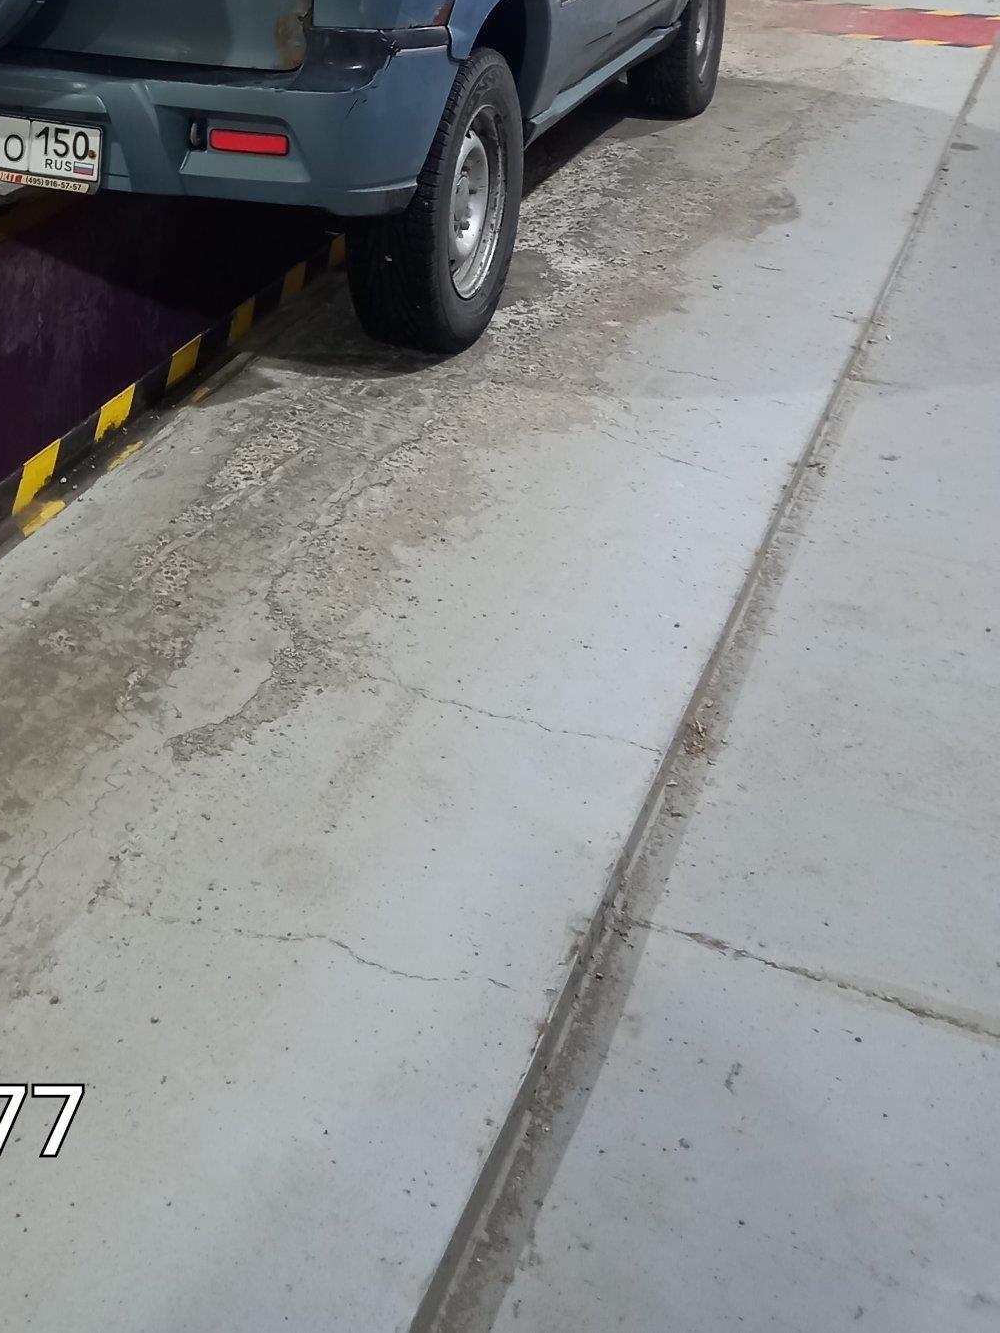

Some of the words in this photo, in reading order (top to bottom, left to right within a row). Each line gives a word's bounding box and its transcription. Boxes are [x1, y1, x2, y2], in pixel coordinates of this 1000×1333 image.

[35, 126, 90, 161] 150
[44, 158, 72, 172] RUS
[25, 176, 44, 186] (495)
[45, 179, 82, 191] 916-57-57
